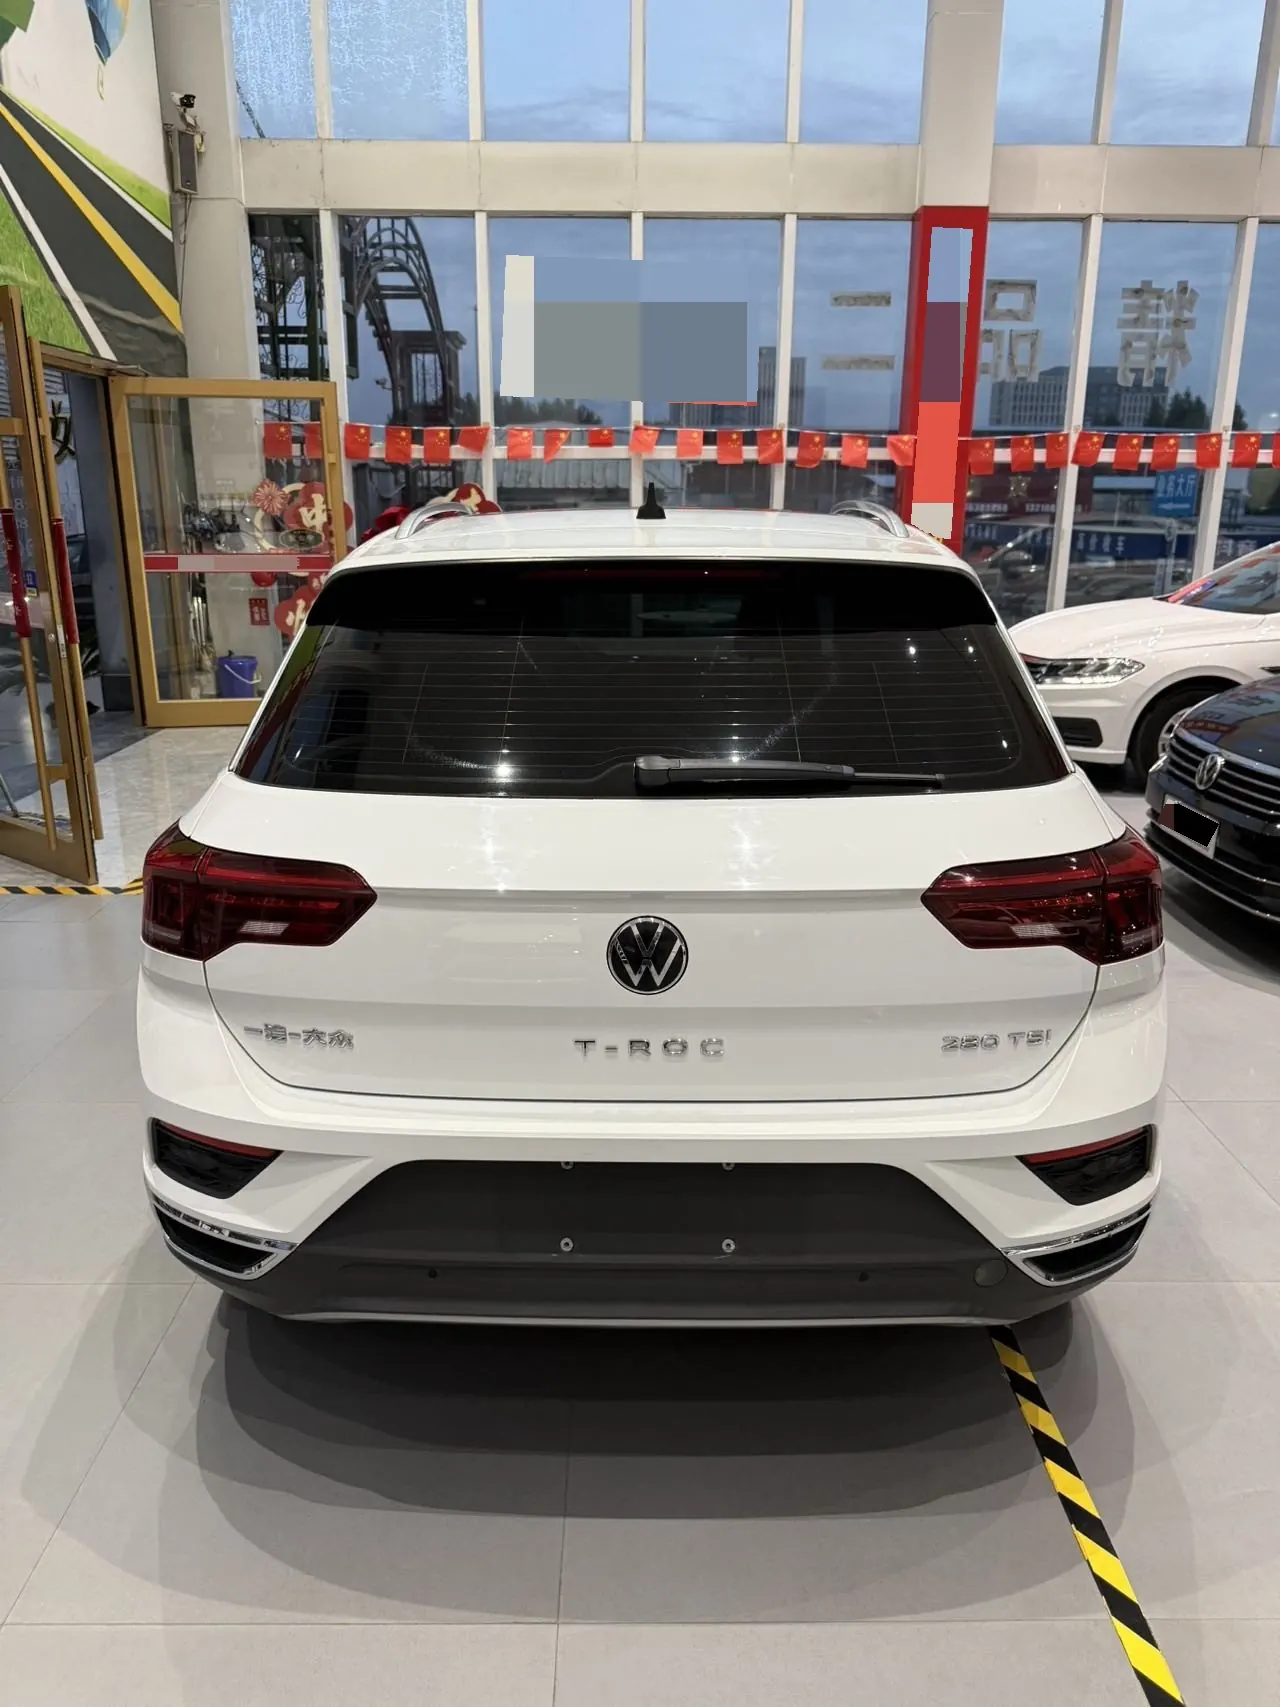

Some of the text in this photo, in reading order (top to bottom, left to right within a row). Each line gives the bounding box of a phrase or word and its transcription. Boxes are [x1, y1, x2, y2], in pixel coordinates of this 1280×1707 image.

[573, 1038, 725, 1058] T-ROC
[941, 1029, 1051, 1051] 280 TSI
